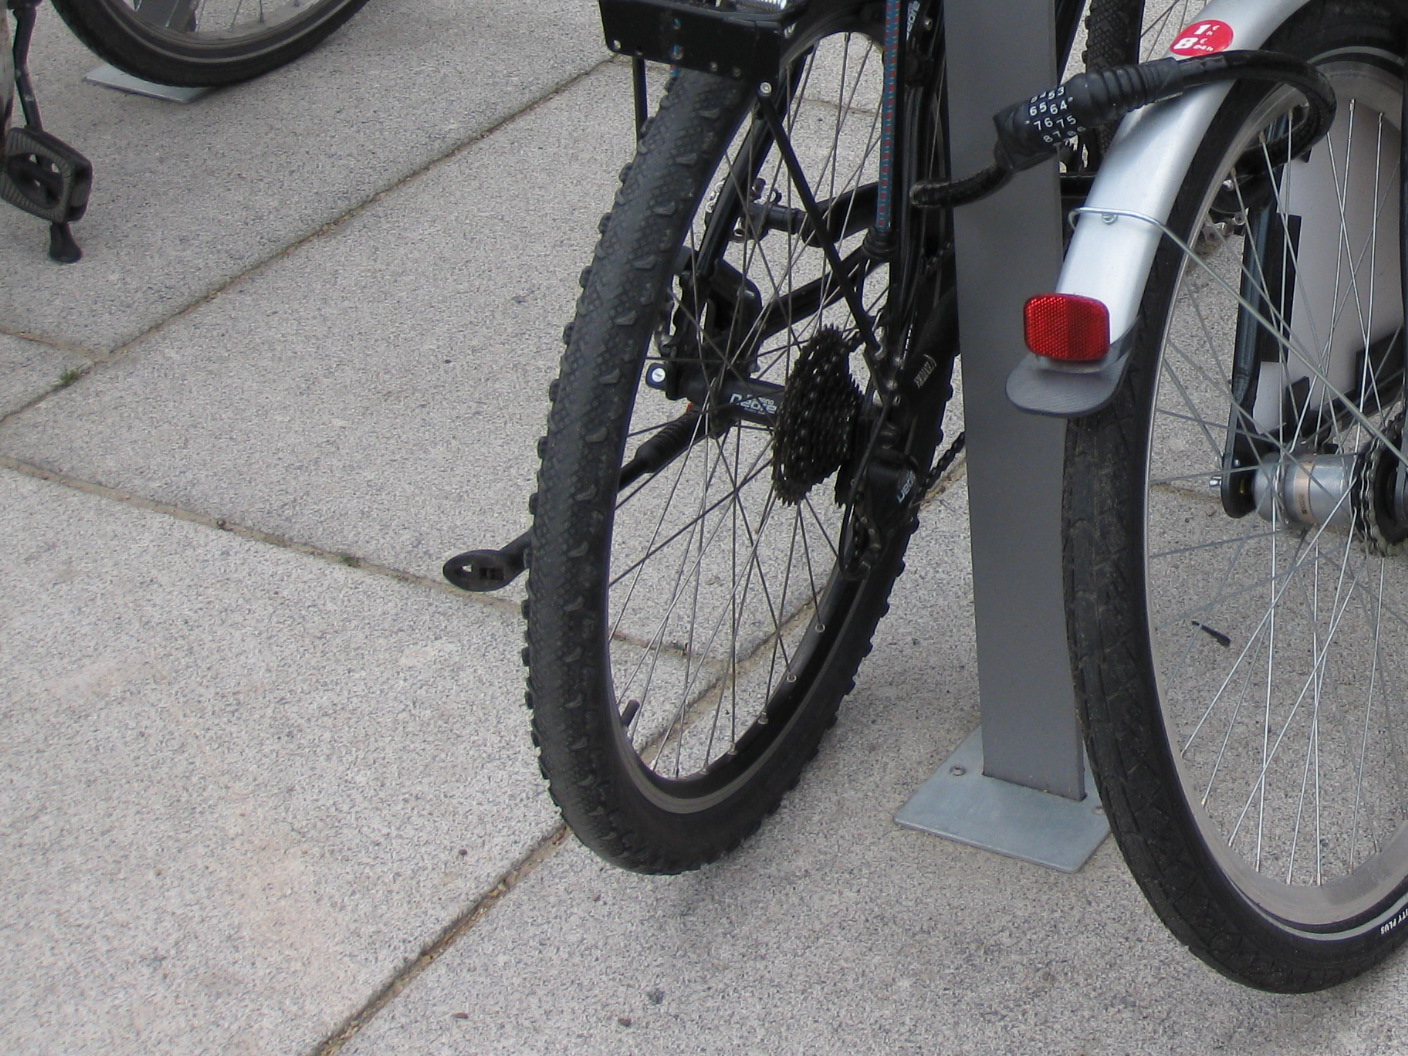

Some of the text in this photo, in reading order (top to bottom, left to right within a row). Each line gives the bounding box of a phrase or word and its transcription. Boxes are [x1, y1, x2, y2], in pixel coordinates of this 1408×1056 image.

[1193, 24, 1212, 35] 1
[1173, 37, 1199, 49] 8
[1380, 917, 1398, 935] PLUS
